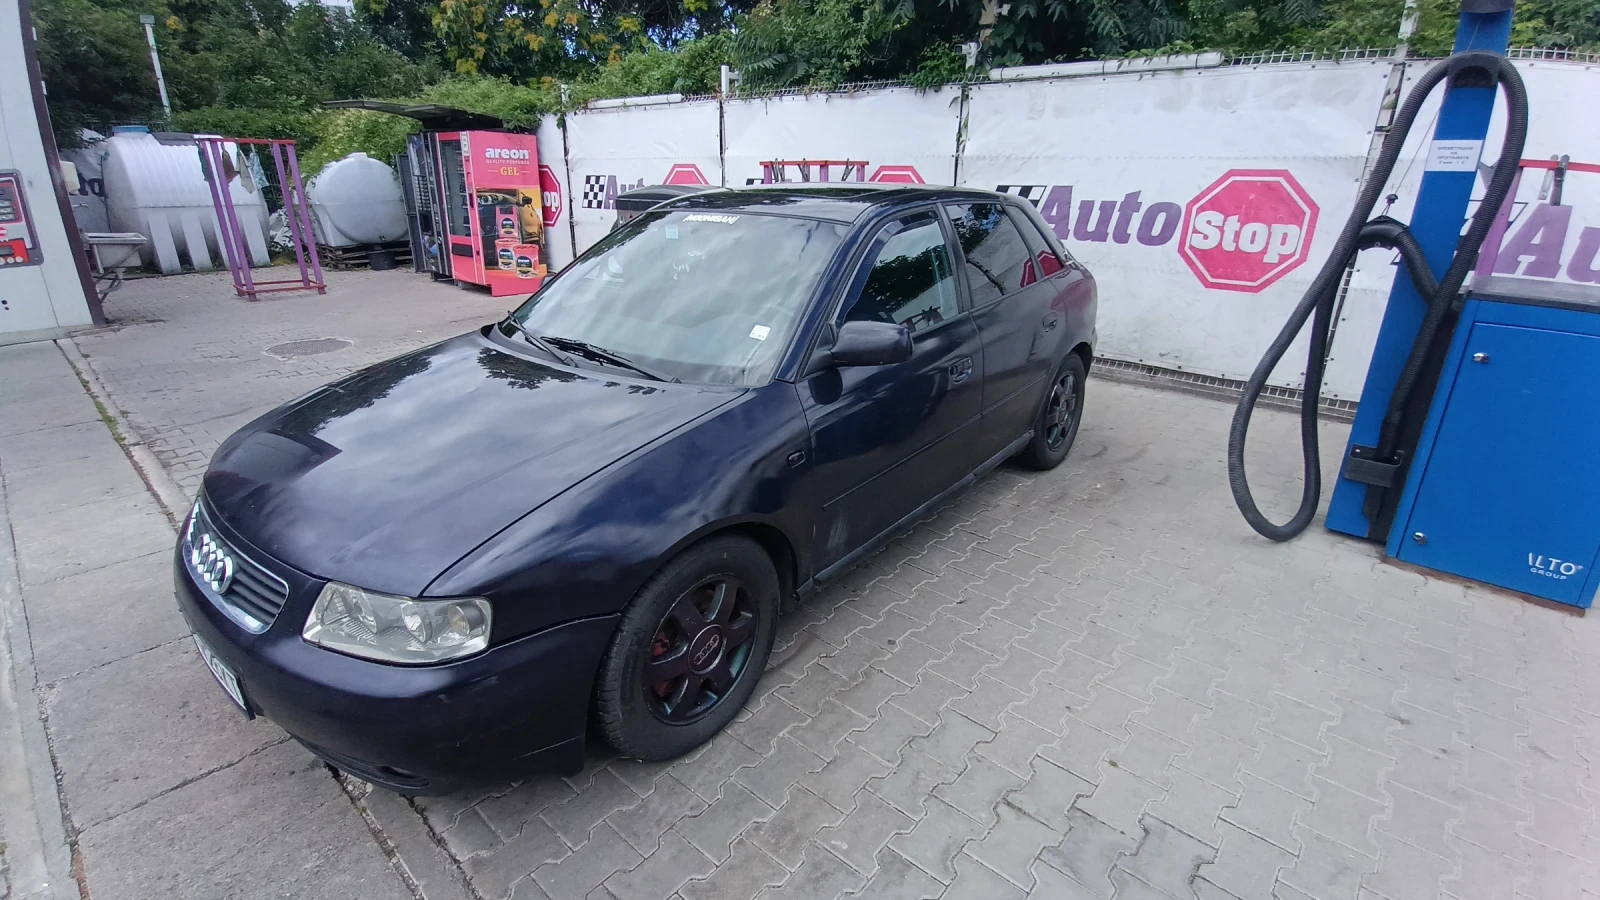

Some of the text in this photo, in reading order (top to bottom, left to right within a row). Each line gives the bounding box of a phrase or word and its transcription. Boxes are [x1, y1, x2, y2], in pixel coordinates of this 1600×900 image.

[485, 148, 529, 159] areon
[500, 166, 520, 176] GEL
[1037, 185, 1300, 263] Auto Stop
[1530, 567, 1567, 580] GROUP
